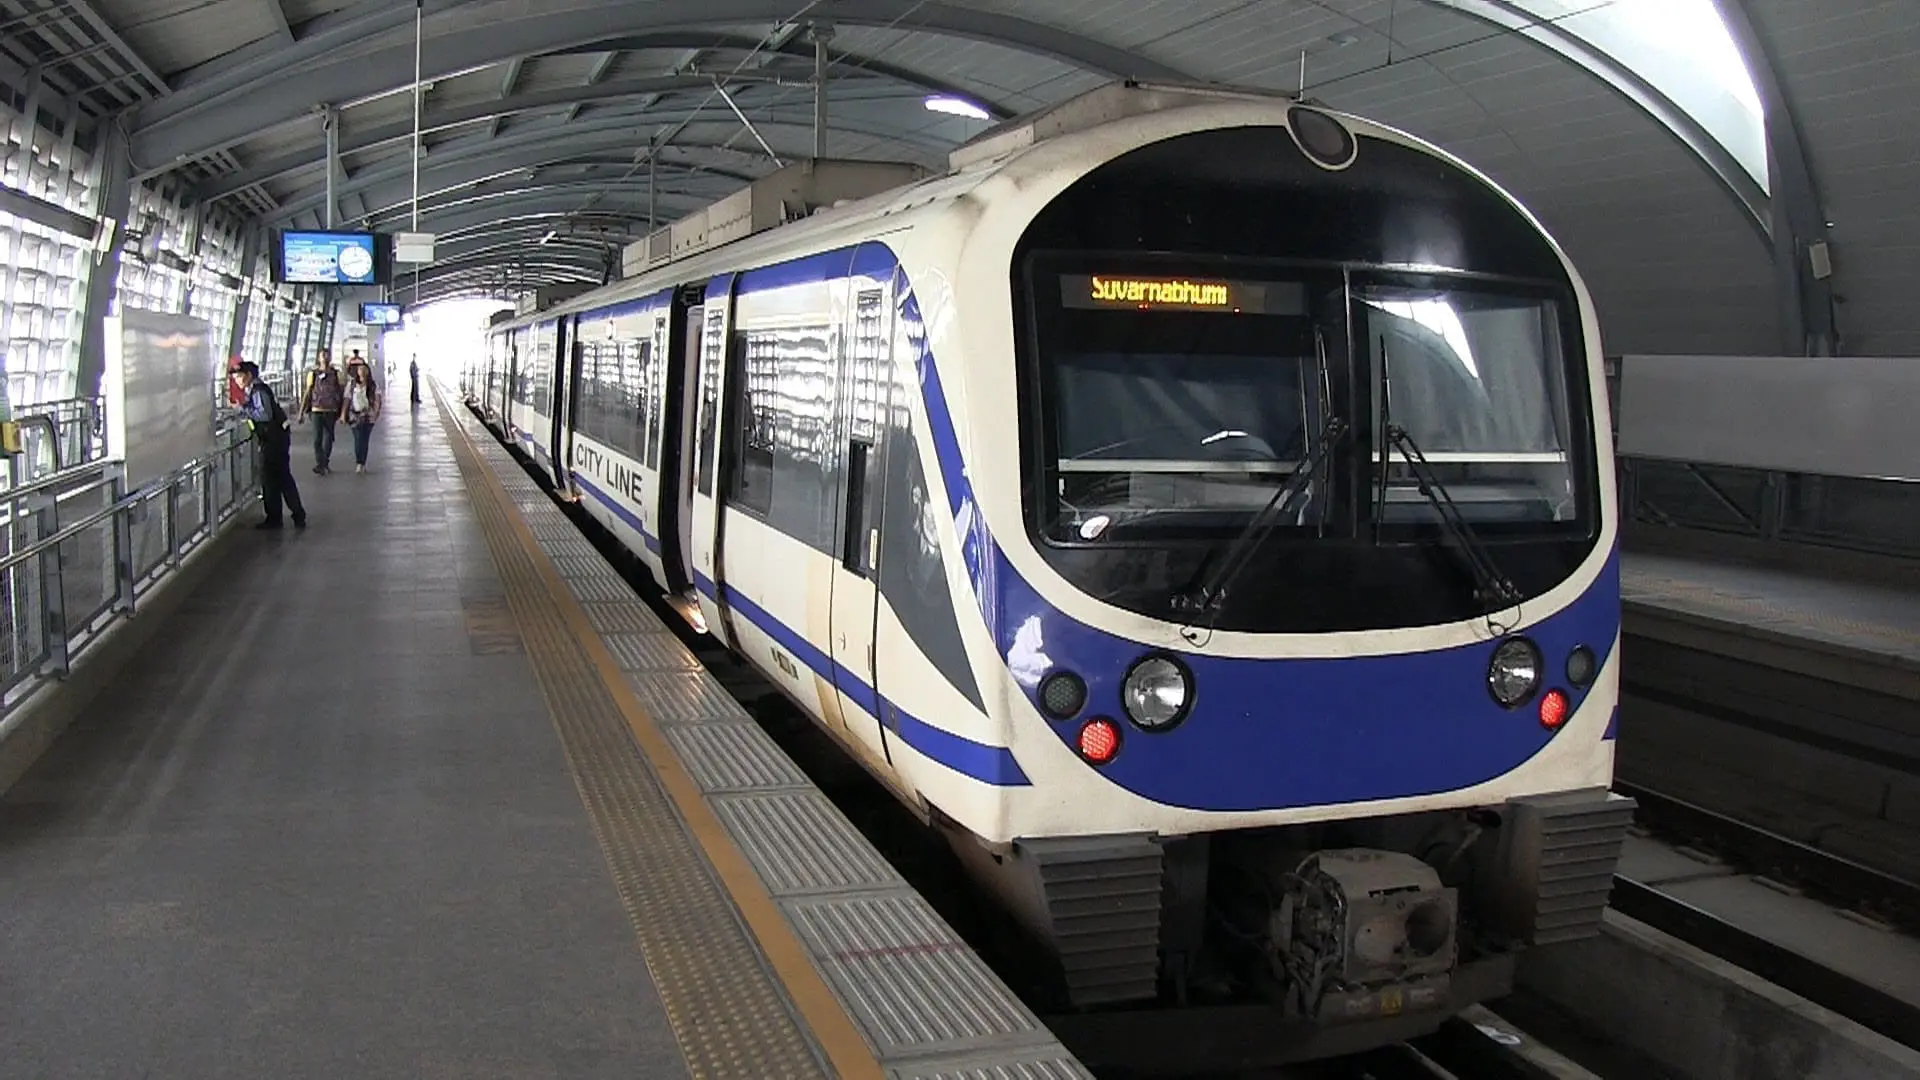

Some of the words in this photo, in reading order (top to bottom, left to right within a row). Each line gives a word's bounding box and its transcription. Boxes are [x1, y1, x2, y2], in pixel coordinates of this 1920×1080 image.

[1091, 276, 1227, 304] Suvarnabhumi
[576, 443, 603, 477] CITY
[606, 458, 643, 506] LINE
